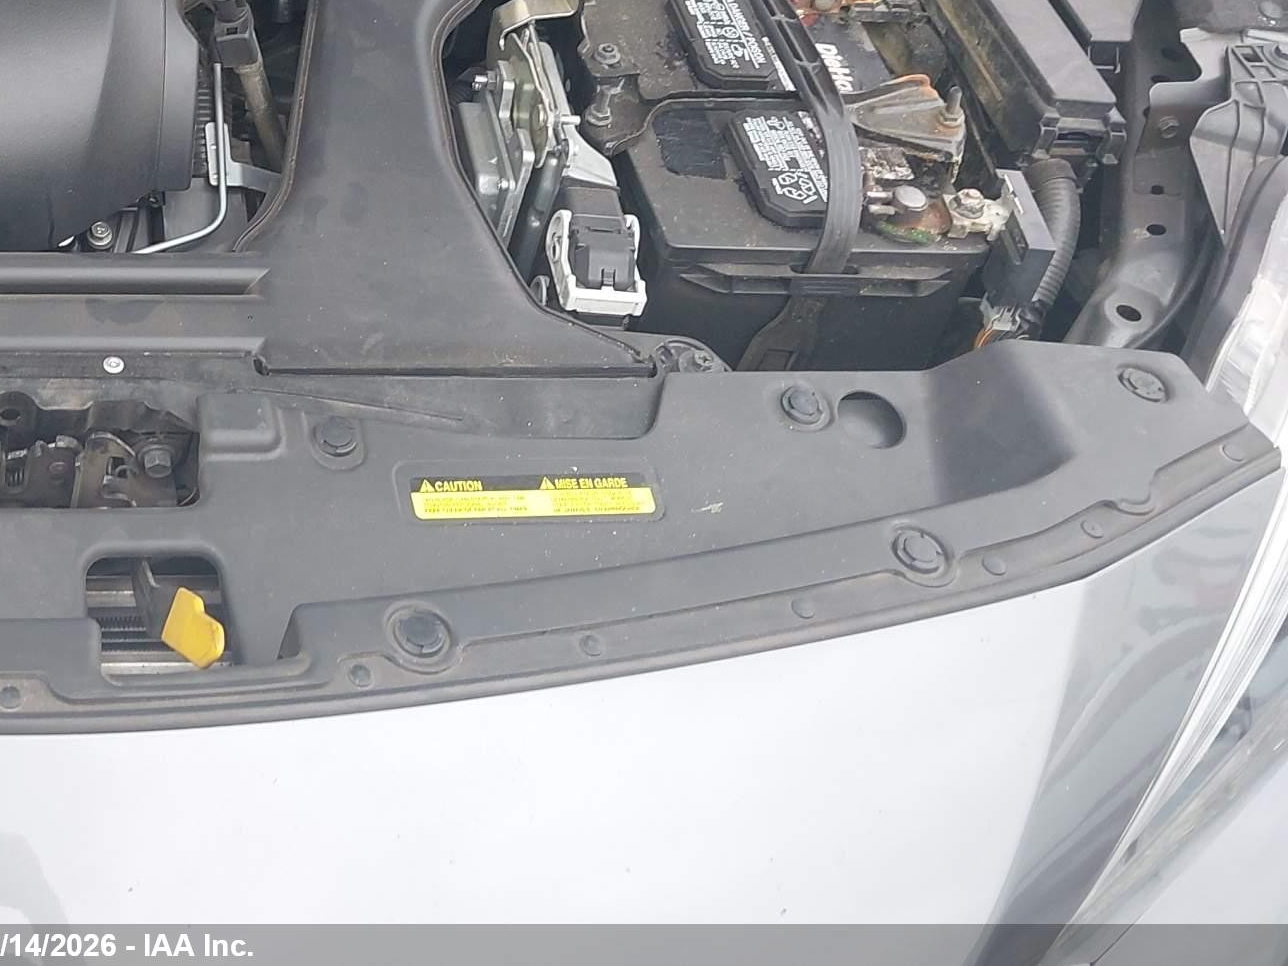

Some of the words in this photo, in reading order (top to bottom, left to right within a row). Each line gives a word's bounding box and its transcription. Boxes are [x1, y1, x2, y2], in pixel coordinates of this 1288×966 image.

[729, 2, 750, 31] DANGER
[745, 36, 767, 64] POISON
[814, 42, 853, 92] DieHa
[434, 480, 483, 492] CAUTION
[554, 478, 579, 489] MISE
[579, 478, 594, 489] EN
[594, 477, 628, 488] GARDE
